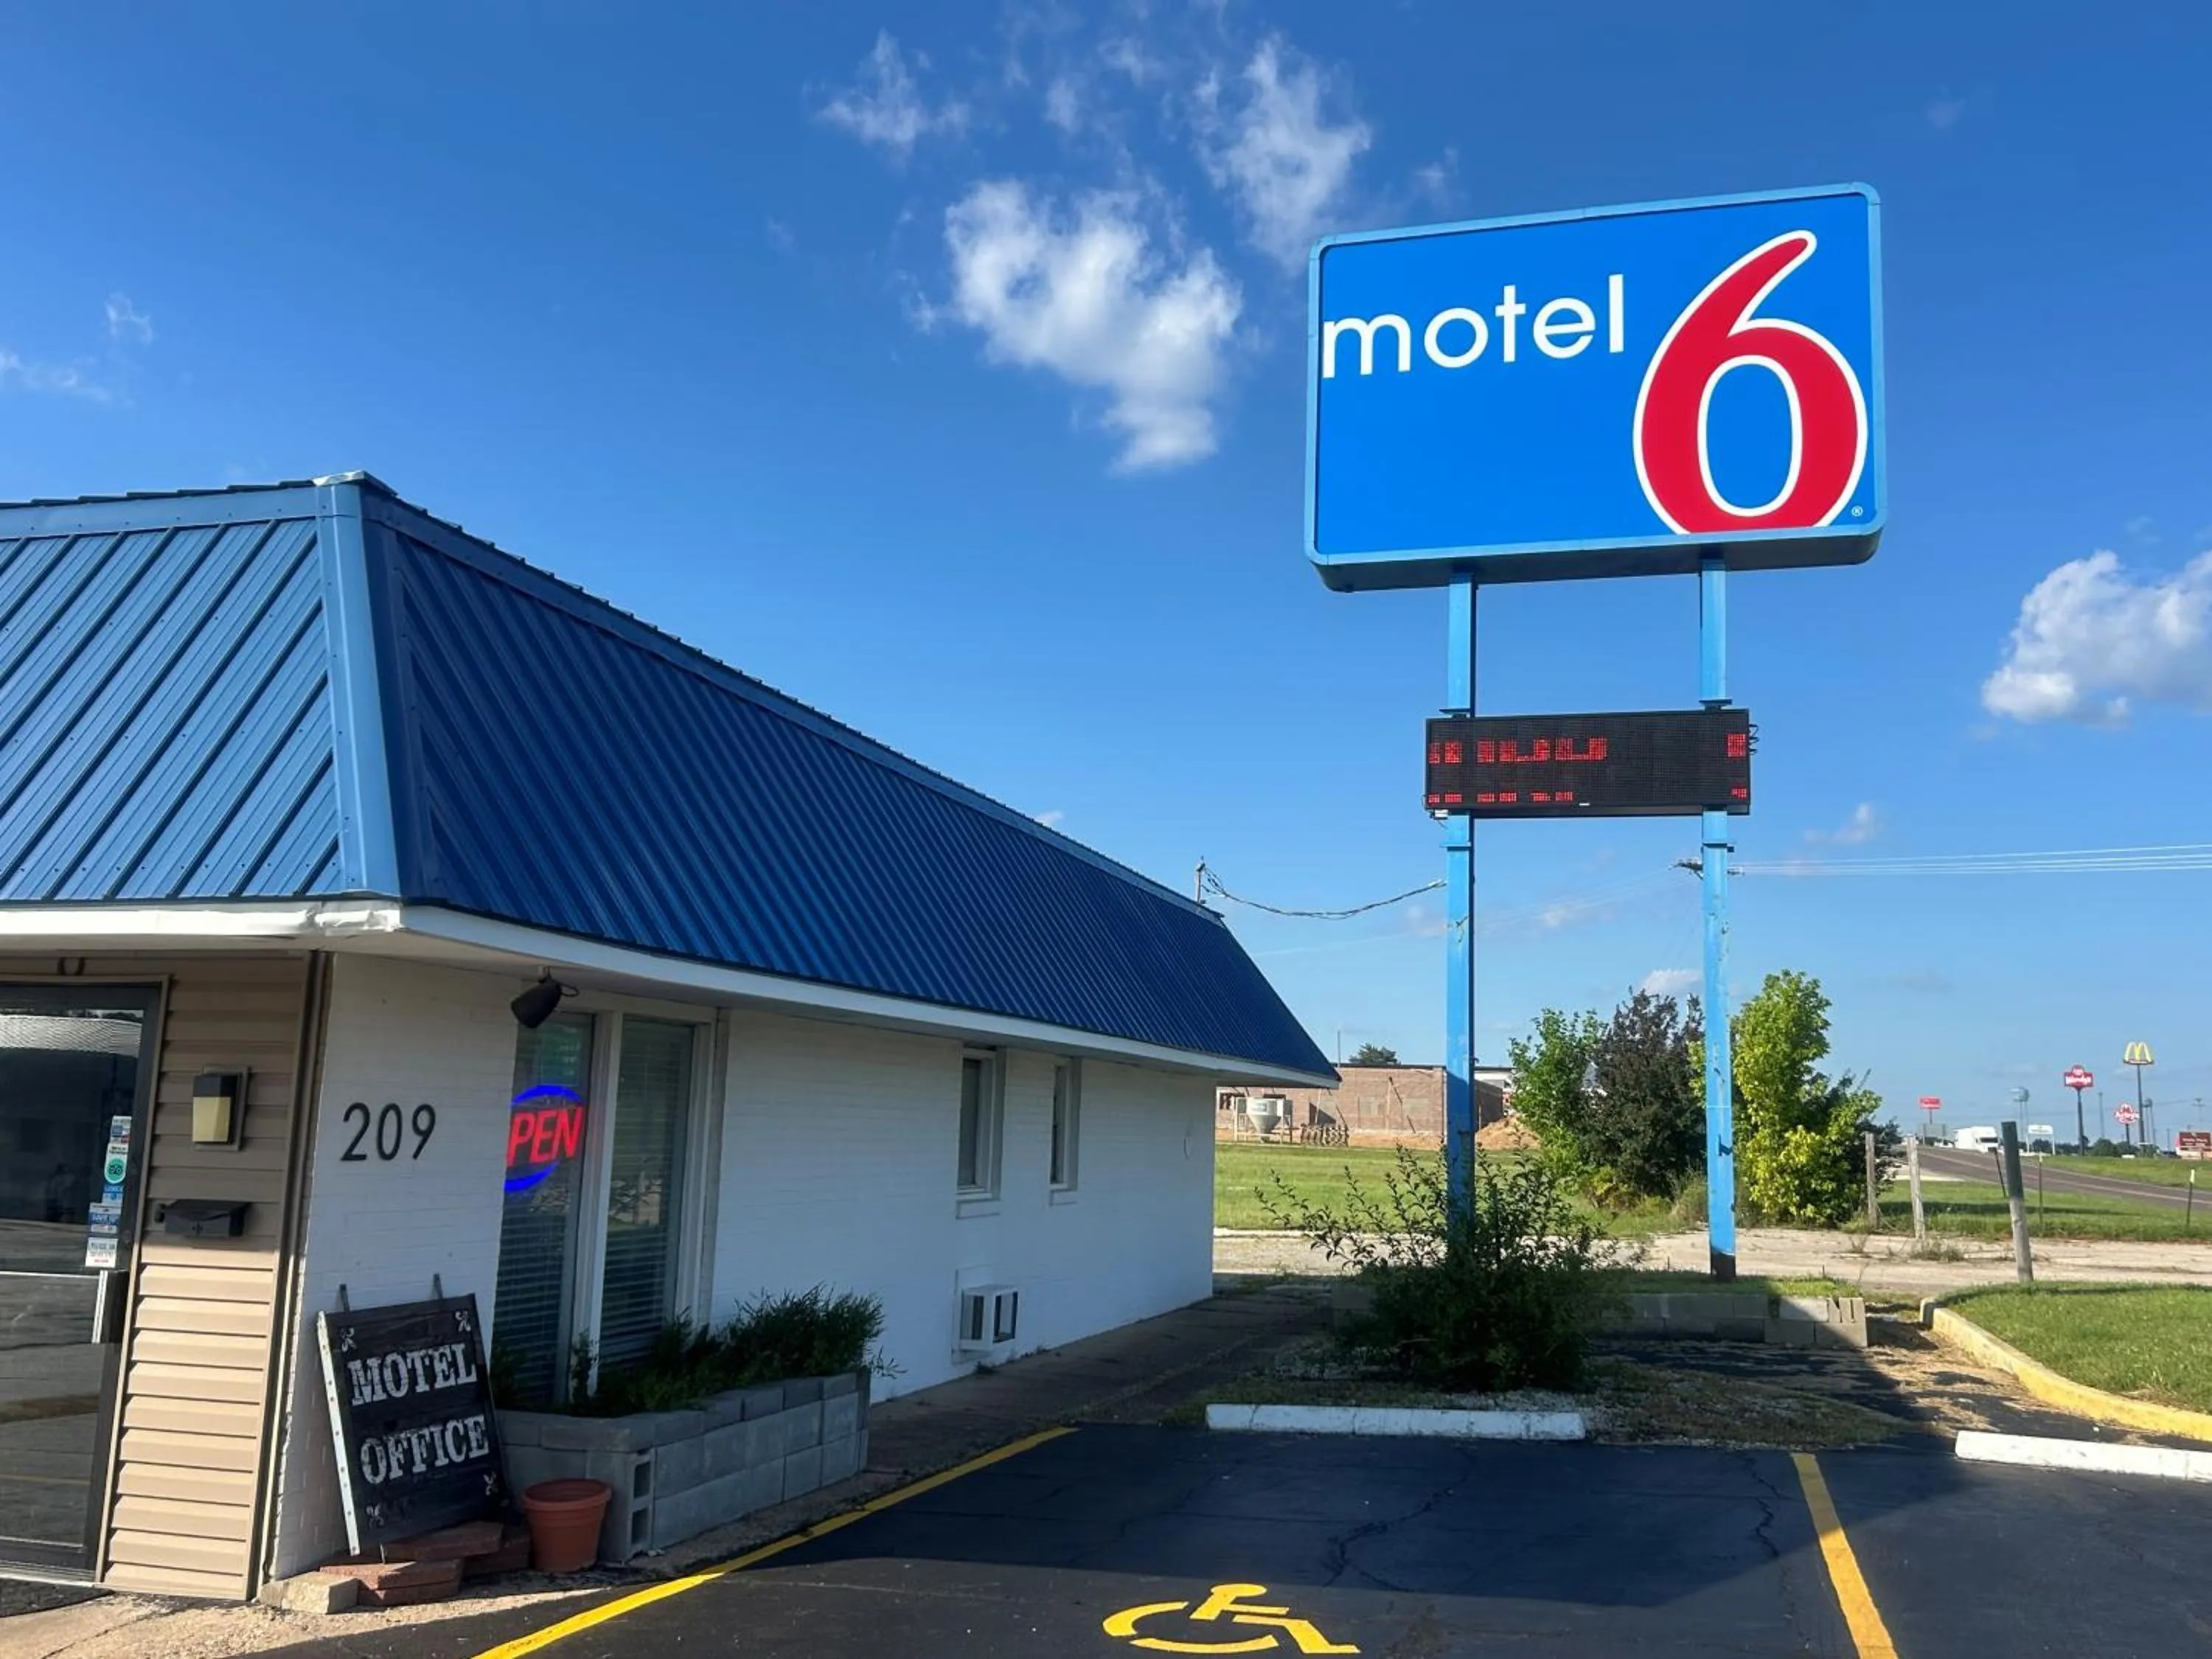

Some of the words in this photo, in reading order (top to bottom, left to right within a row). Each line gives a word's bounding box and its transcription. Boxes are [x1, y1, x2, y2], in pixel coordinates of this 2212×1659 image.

[1322, 274, 1624, 378] motel
[1632, 229, 1868, 535] 6
[339, 1102, 437, 1161] 209
[506, 1105, 584, 1168] PEN
[347, 1343, 478, 1406] MOTEL
[361, 1414, 490, 1484] OFFICE
